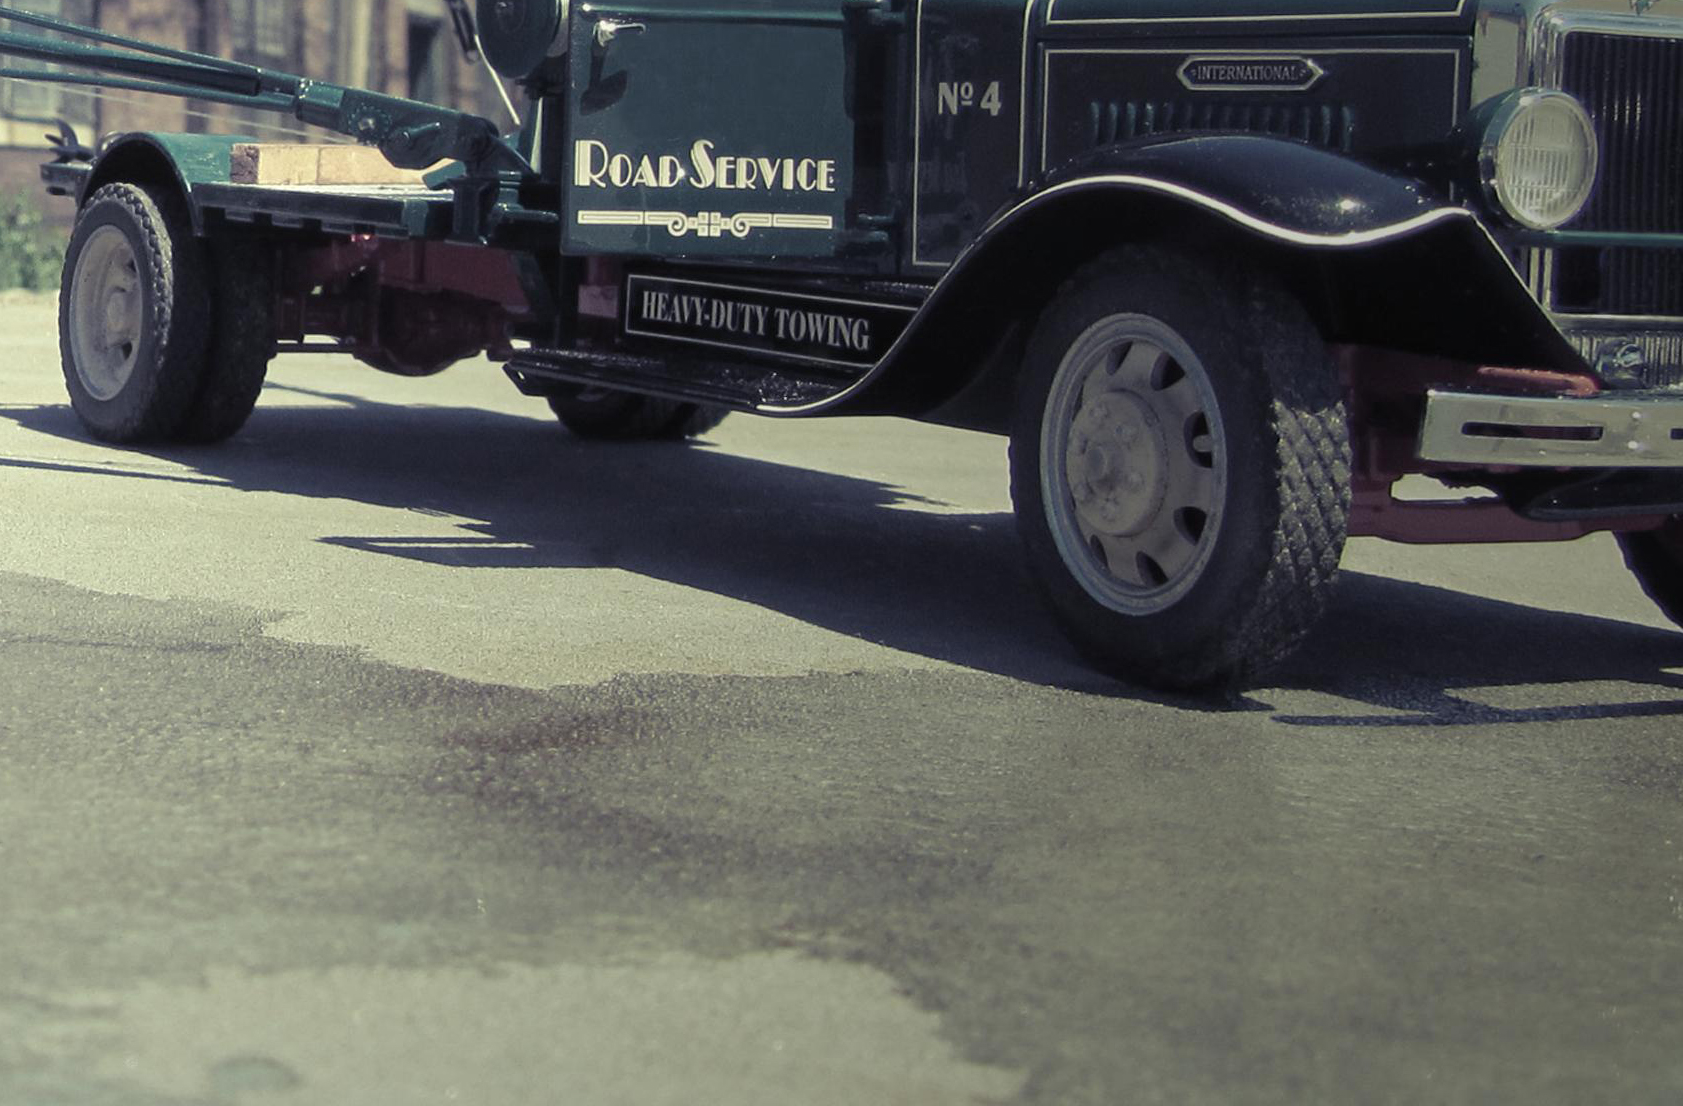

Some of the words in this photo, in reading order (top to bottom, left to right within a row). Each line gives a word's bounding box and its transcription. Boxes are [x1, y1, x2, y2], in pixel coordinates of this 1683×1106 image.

[1197, 65, 1299, 81] INTERNATIONAL
[980, 81, 1001, 116] 4
[574, 139, 681, 188] ROAD
[689, 139, 836, 192] SERVICE
[642, 290, 770, 336] HEAVY-DUTY
[774, 308, 871, 351] TOWING
